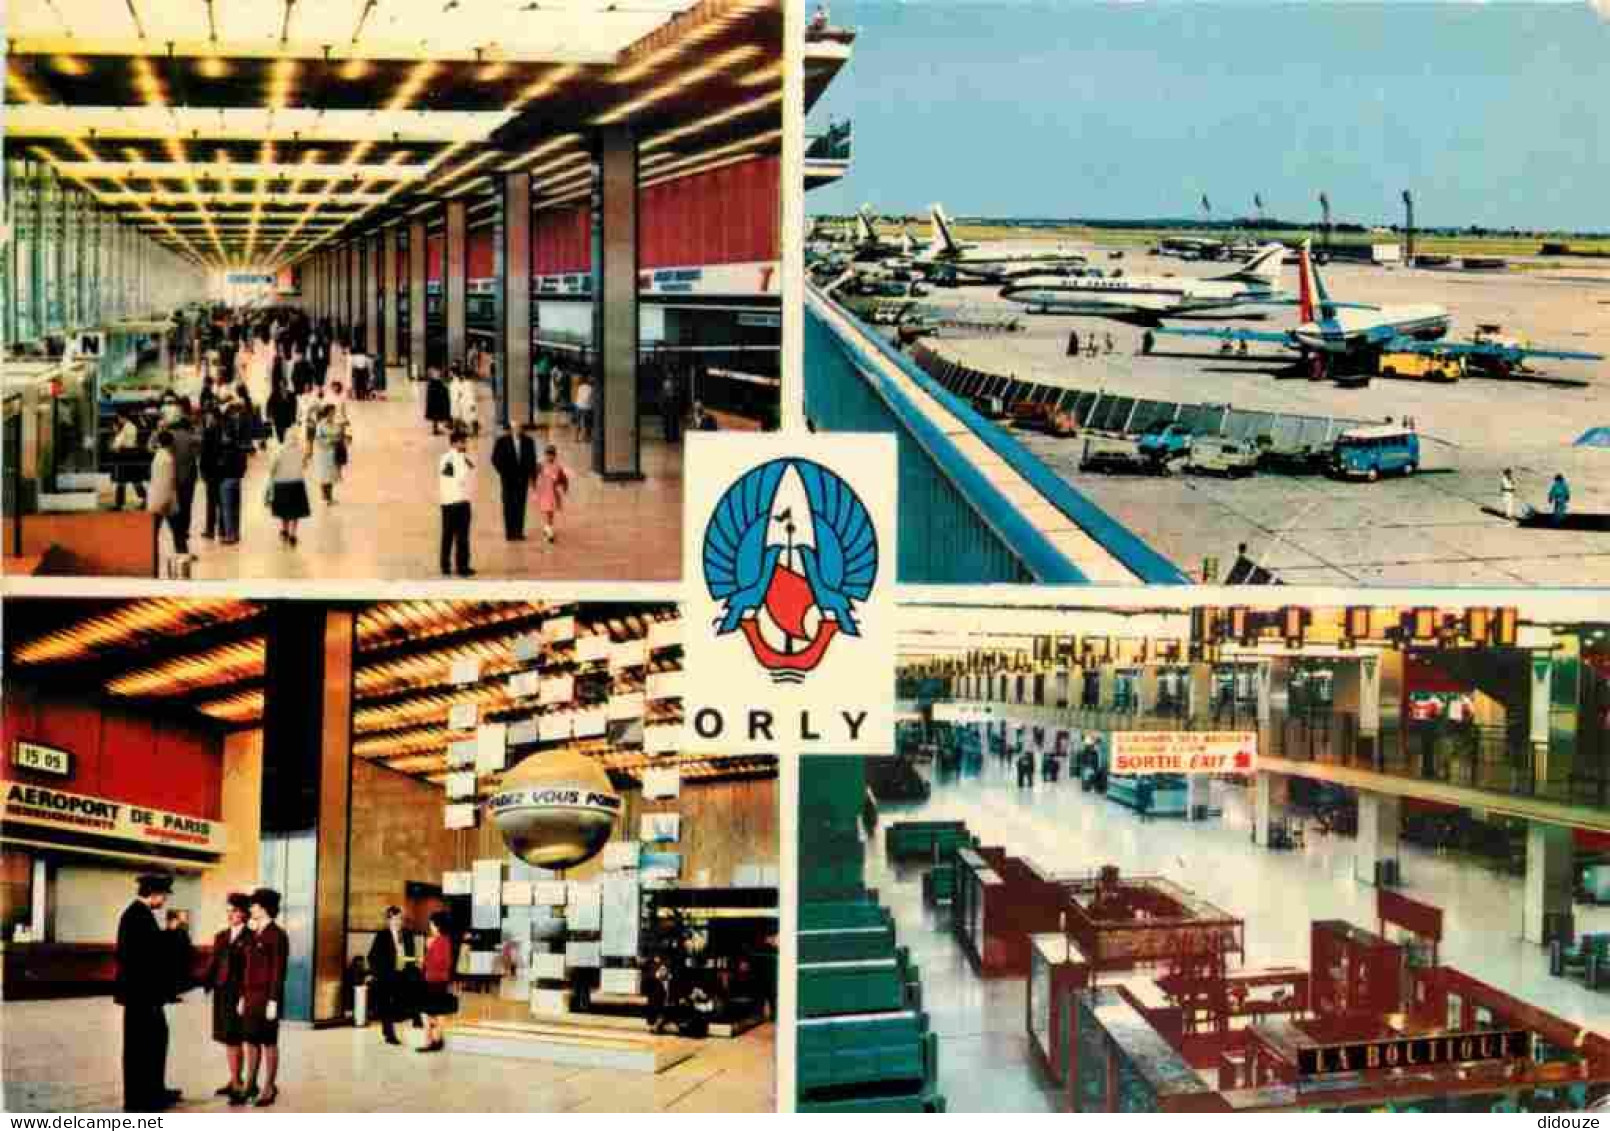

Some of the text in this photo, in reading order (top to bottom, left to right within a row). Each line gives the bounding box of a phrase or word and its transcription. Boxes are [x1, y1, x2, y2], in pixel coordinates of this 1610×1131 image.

[82, 335, 99, 353] N
[694, 708, 867, 740] ORLY
[24, 748, 39, 765] 15
[1117, 753, 1227, 768] SORTIE EXIT
[531, 790, 579, 804] VOUS
[7, 785, 210, 835] AEROPORT DE PARIS
